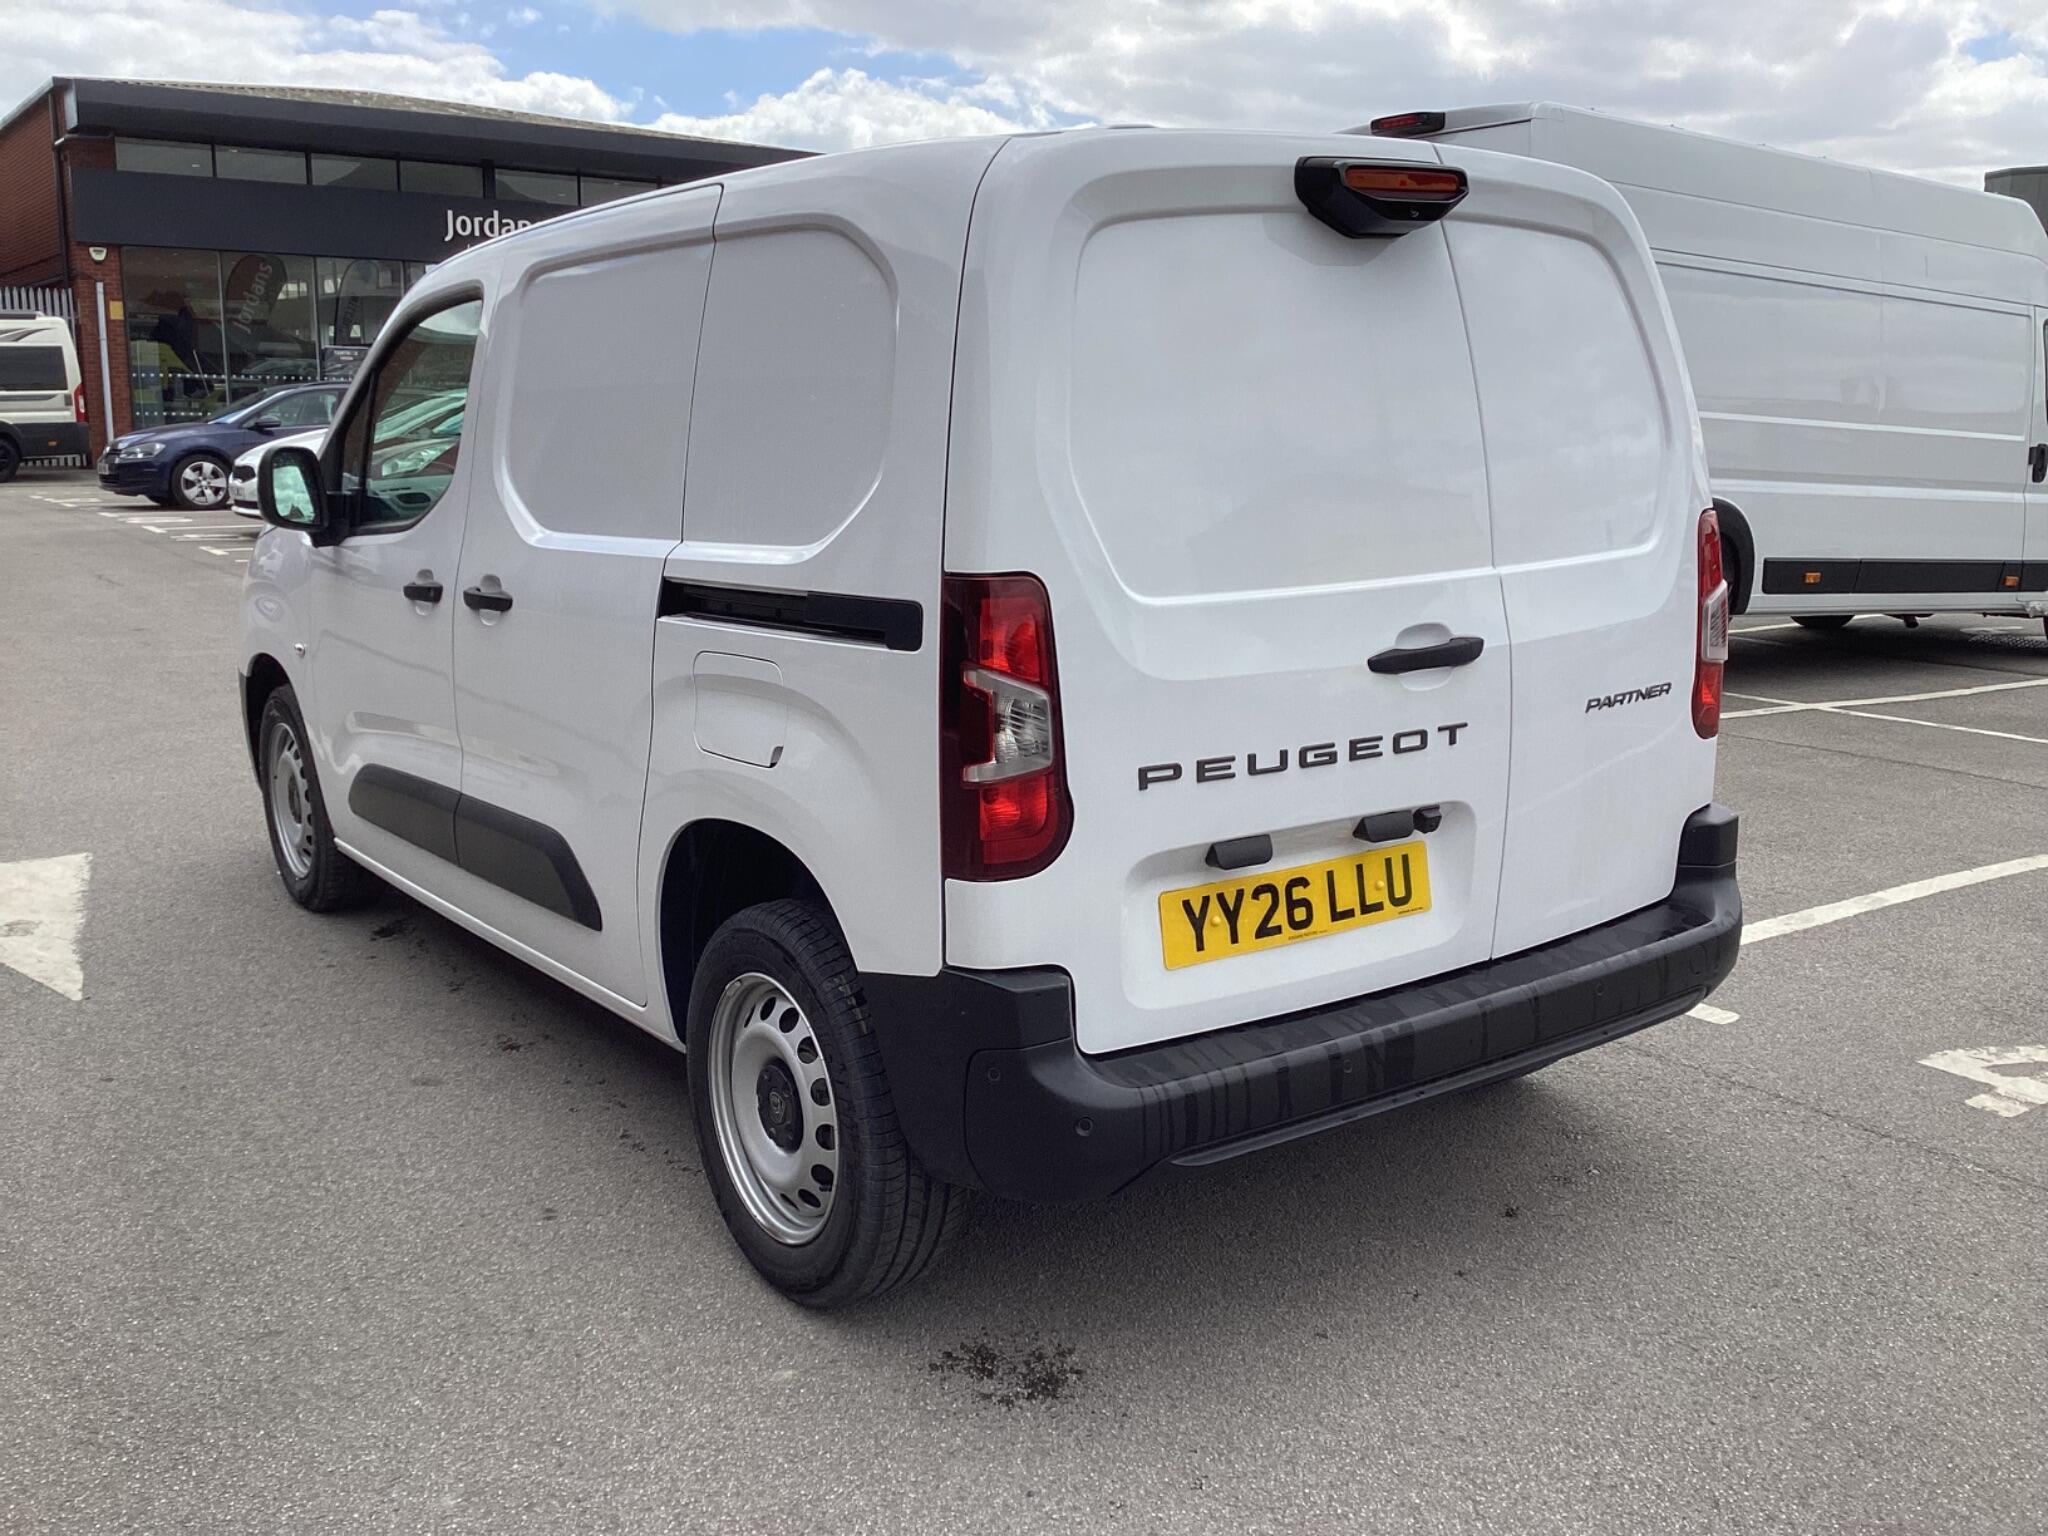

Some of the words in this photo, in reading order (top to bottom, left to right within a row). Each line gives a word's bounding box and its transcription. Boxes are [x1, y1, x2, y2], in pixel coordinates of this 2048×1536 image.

[444, 209, 542, 241] Jordan
[1584, 682, 1672, 714] PARTNER
[1137, 721, 1468, 791] PEUGEOT
[1181, 876, 1314, 952] YY26
[1326, 853, 1413, 923] LLU
